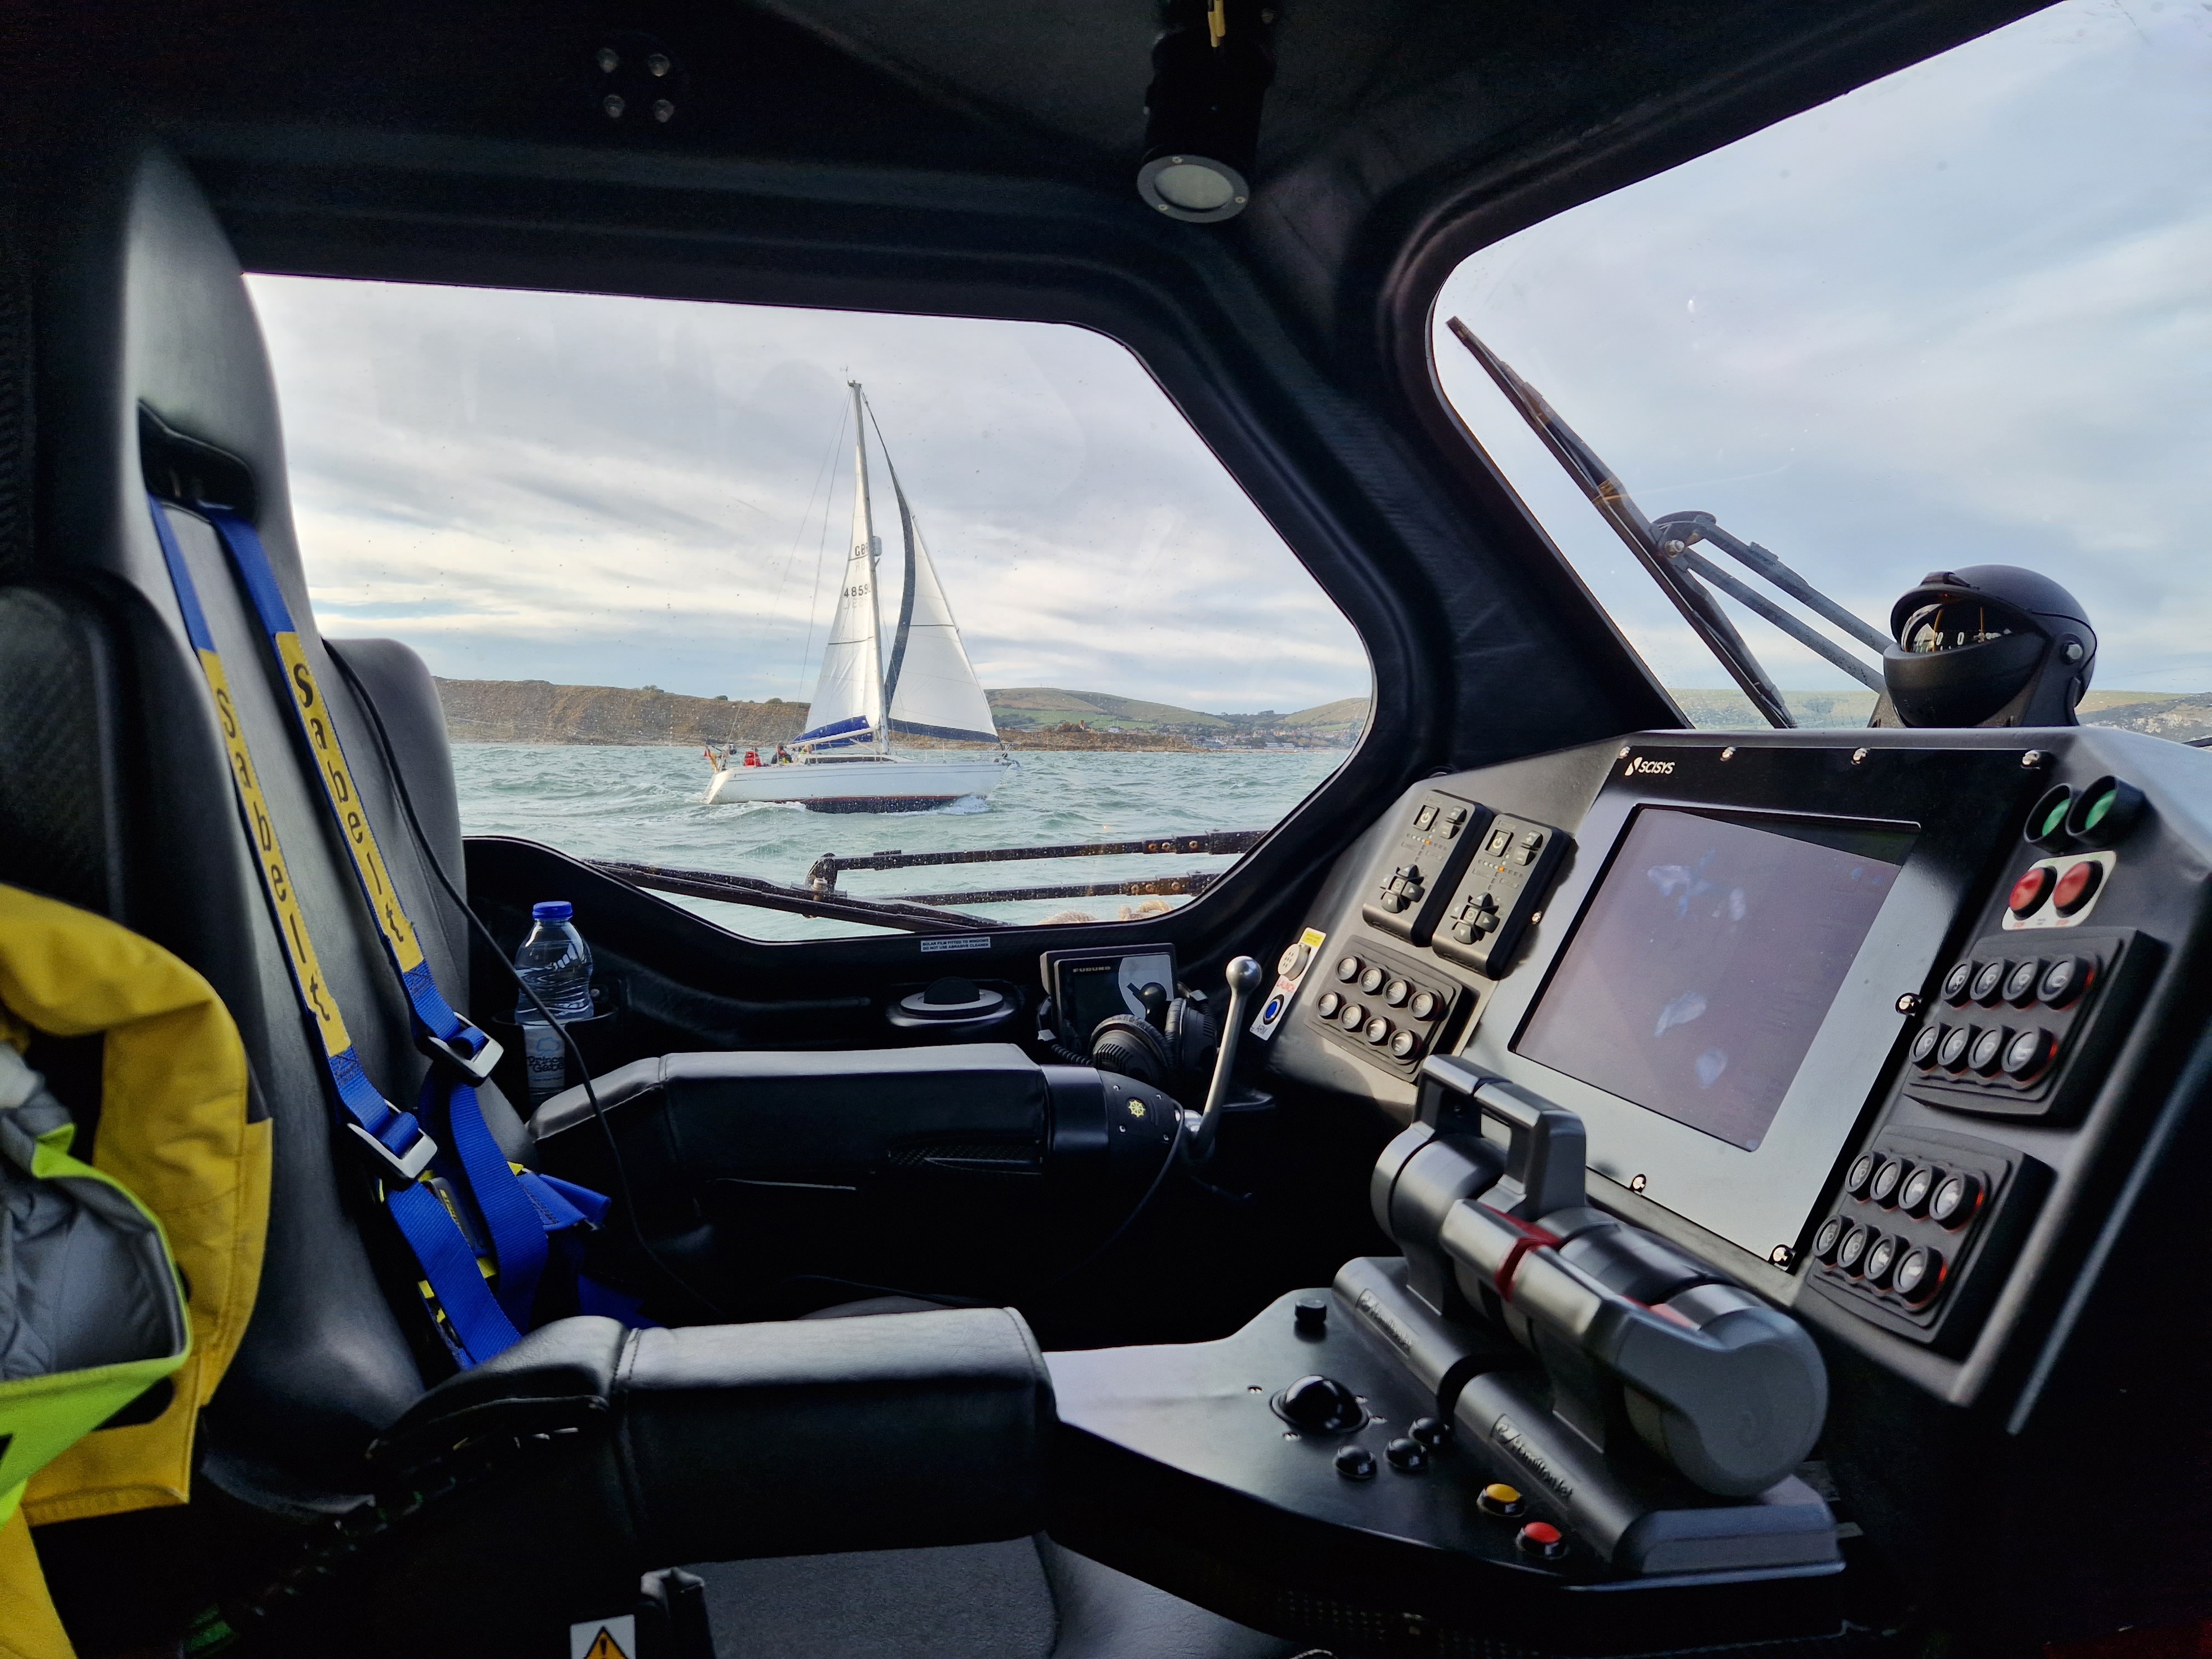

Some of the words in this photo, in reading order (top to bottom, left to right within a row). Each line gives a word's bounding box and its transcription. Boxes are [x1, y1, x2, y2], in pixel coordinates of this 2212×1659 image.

[1638, 760, 1676, 774] SCISYS
[293, 663, 404, 943] Sabelt
[216, 688, 331, 1021] Sabelt
[1277, 979, 1296, 993] LAUNCH
[1255, 1023, 1268, 1036] ARM
